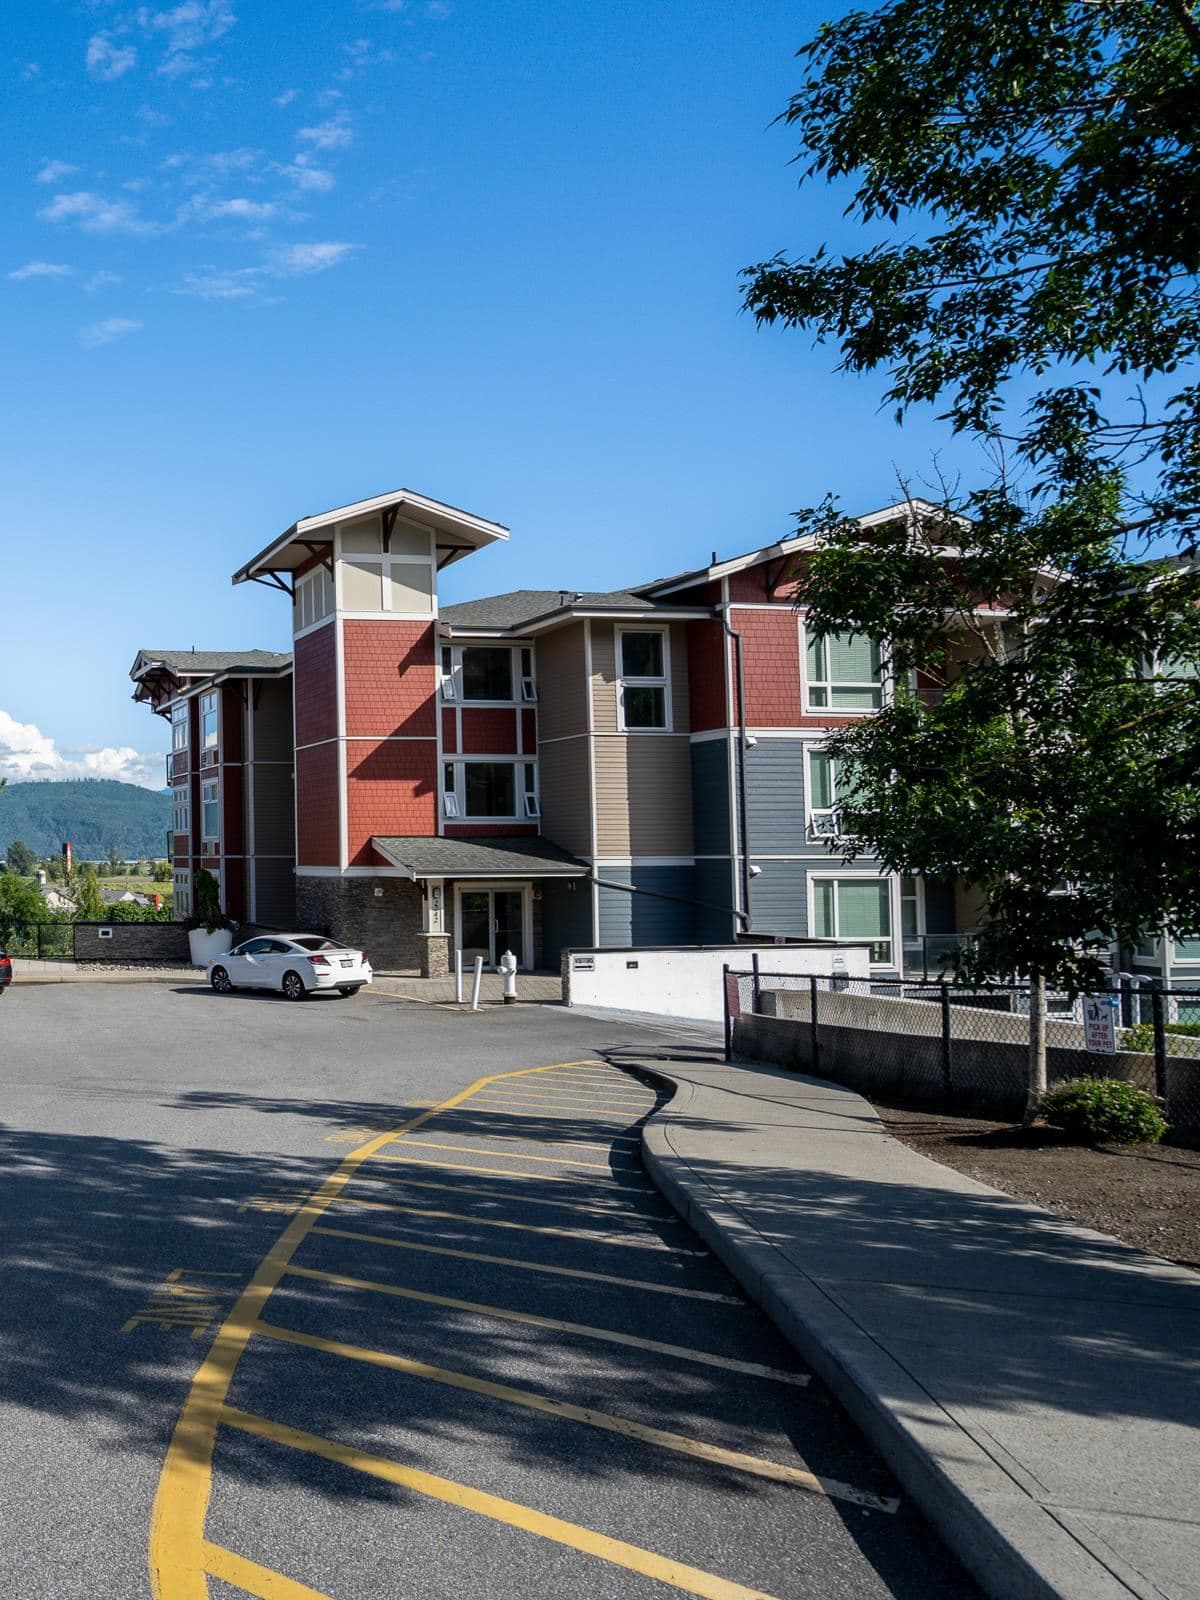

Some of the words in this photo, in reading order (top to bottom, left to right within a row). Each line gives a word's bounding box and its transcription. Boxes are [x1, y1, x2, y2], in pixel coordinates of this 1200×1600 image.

[1088, 1023, 1101, 1031] PICK
[1091, 1031, 1108, 1039] AFTER
[1088, 1039, 1101, 1047] YOUR
[1103, 1040, 1113, 1048] PET
[119, 1268, 242, 1340] LANE
